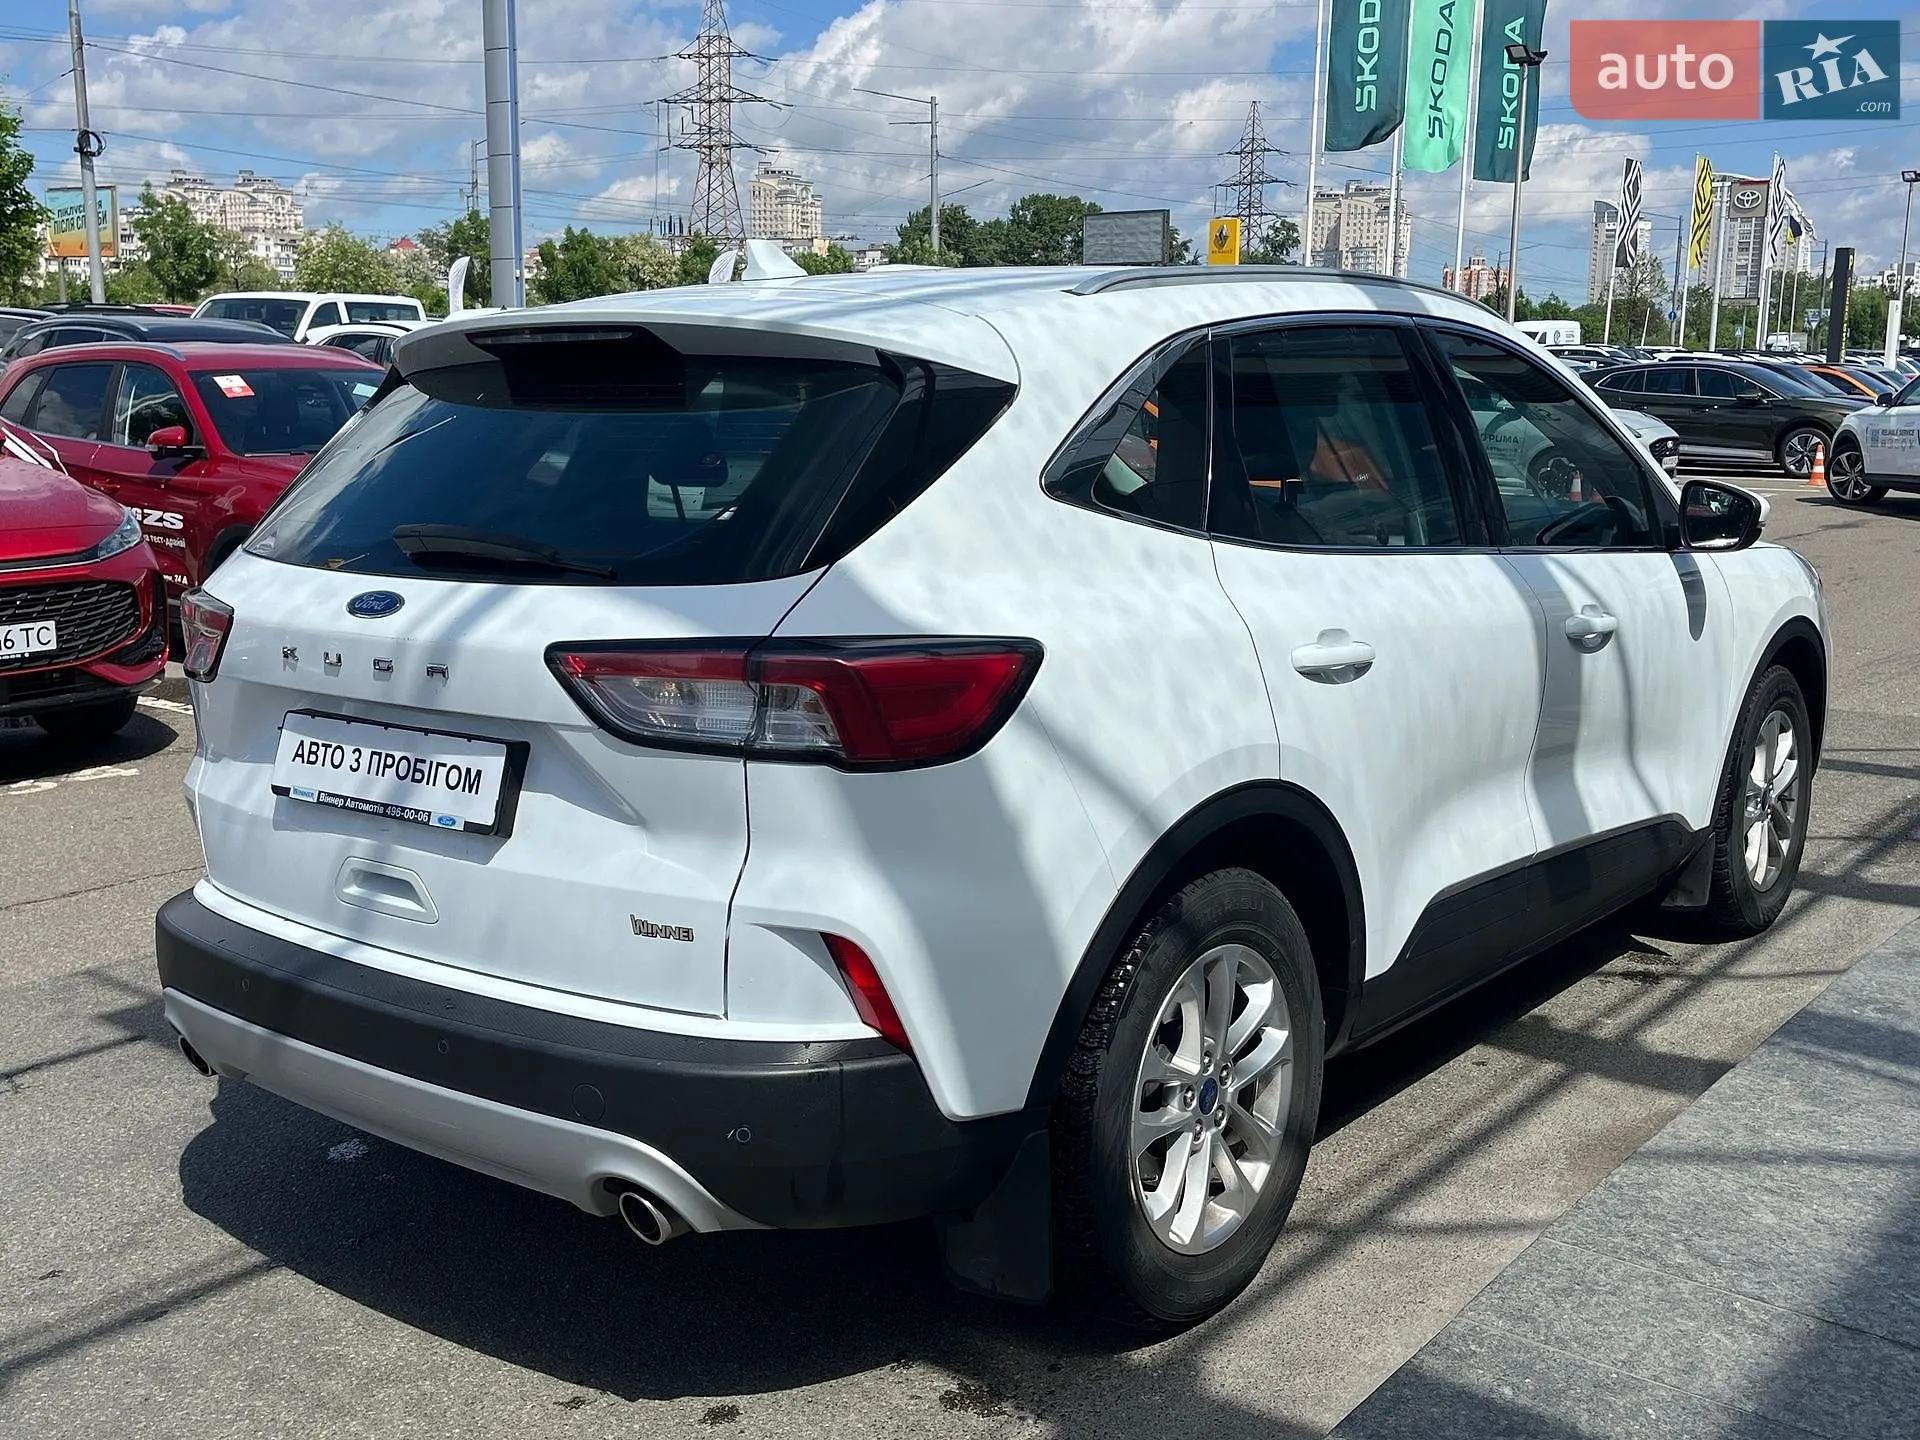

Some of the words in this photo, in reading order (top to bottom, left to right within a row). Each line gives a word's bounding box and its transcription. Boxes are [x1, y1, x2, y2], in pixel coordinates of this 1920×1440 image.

[76, 209, 107, 230] СЛБИ
[143, 508, 184, 529] ZS
[282, 646, 450, 680] KUGA
[292, 739, 346, 770] АВТО
[366, 750, 483, 795] ПРОБІГОМ
[319, 792, 344, 808] Віннер
[345, 797, 384, 814] Автомотів
[386, 805, 429, 822] 496-00-06
